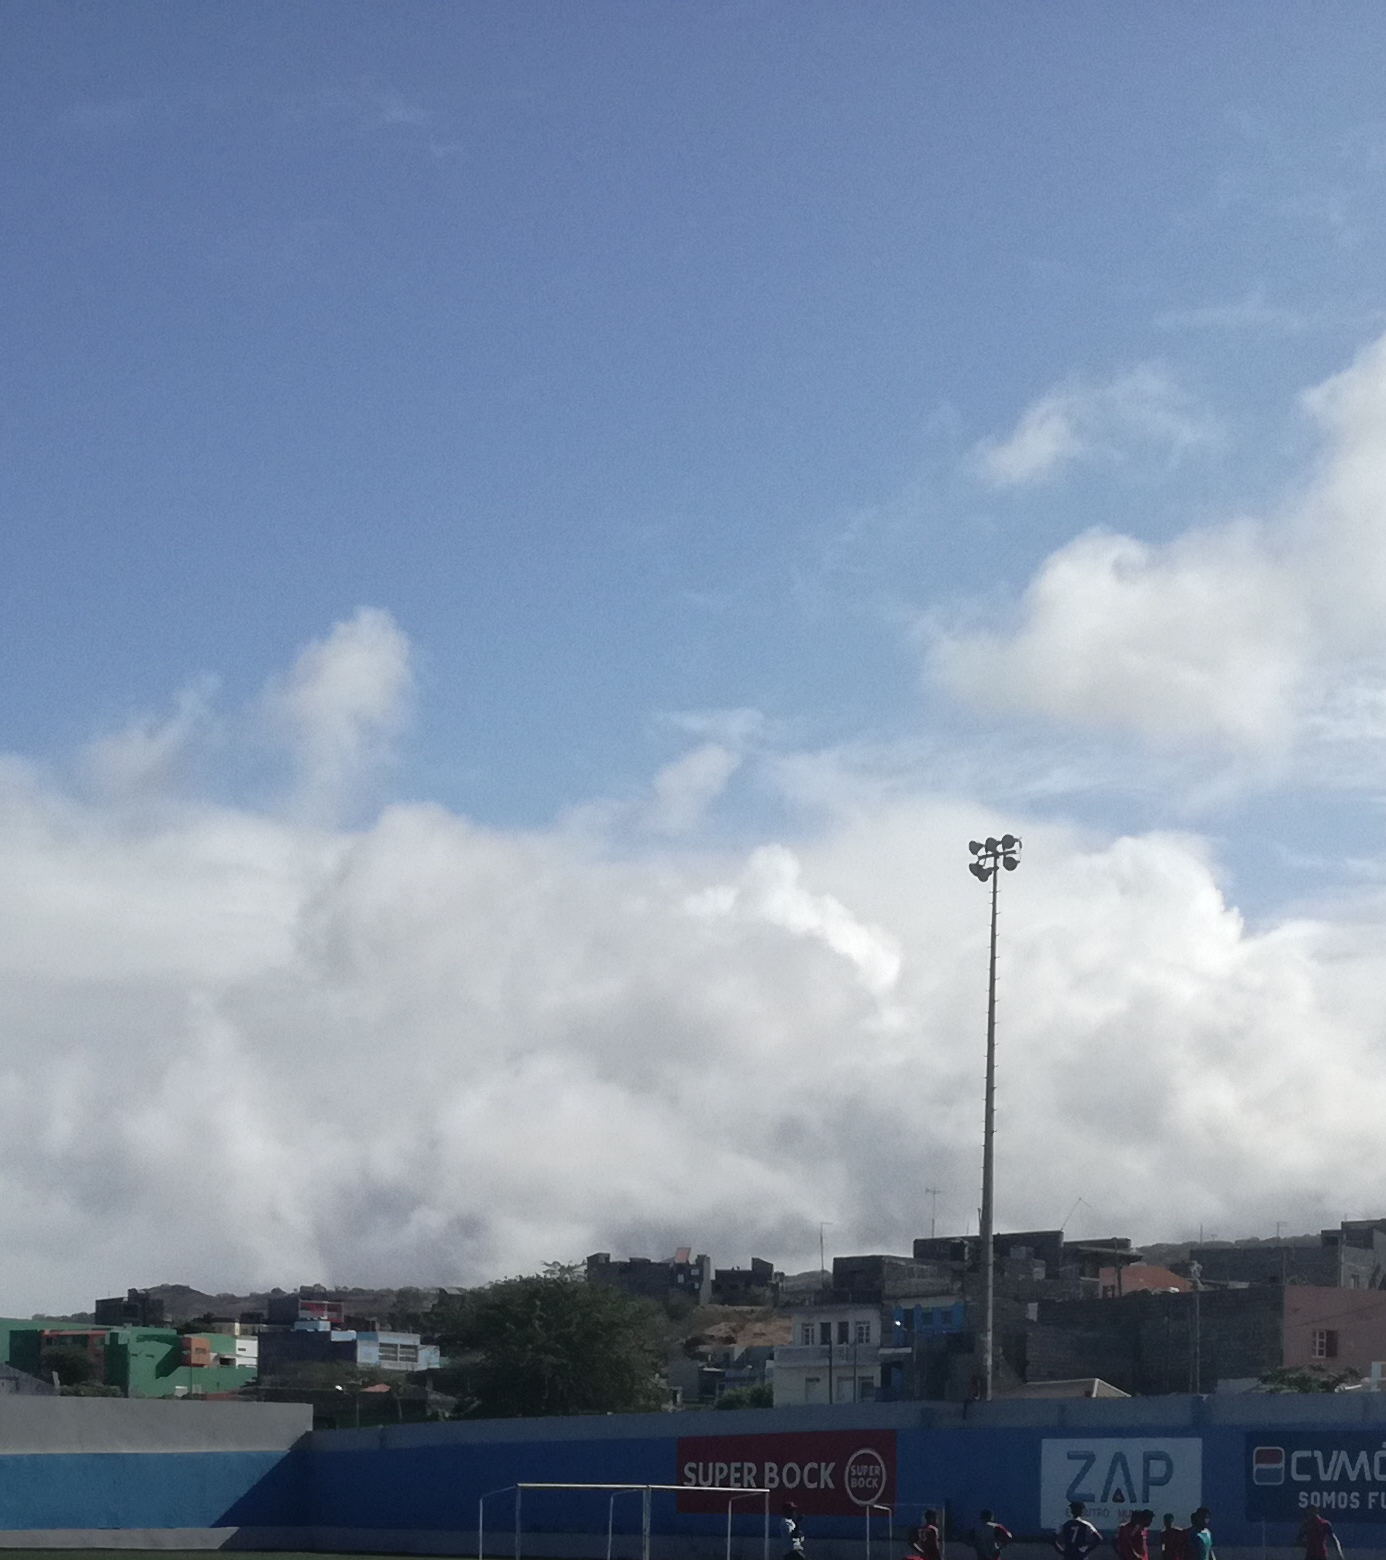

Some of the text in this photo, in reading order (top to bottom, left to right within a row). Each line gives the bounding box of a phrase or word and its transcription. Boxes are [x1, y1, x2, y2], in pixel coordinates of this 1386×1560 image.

[683, 1461, 835, 1489] SUPER BOCK
[850, 1465, 881, 1477] SUPER
[1066, 1451, 1173, 1503] ZAP
[851, 1477, 879, 1489] BOCK
[1298, 1491, 1360, 1509] SOMOS
[1070, 1526, 1080, 1543] 7
